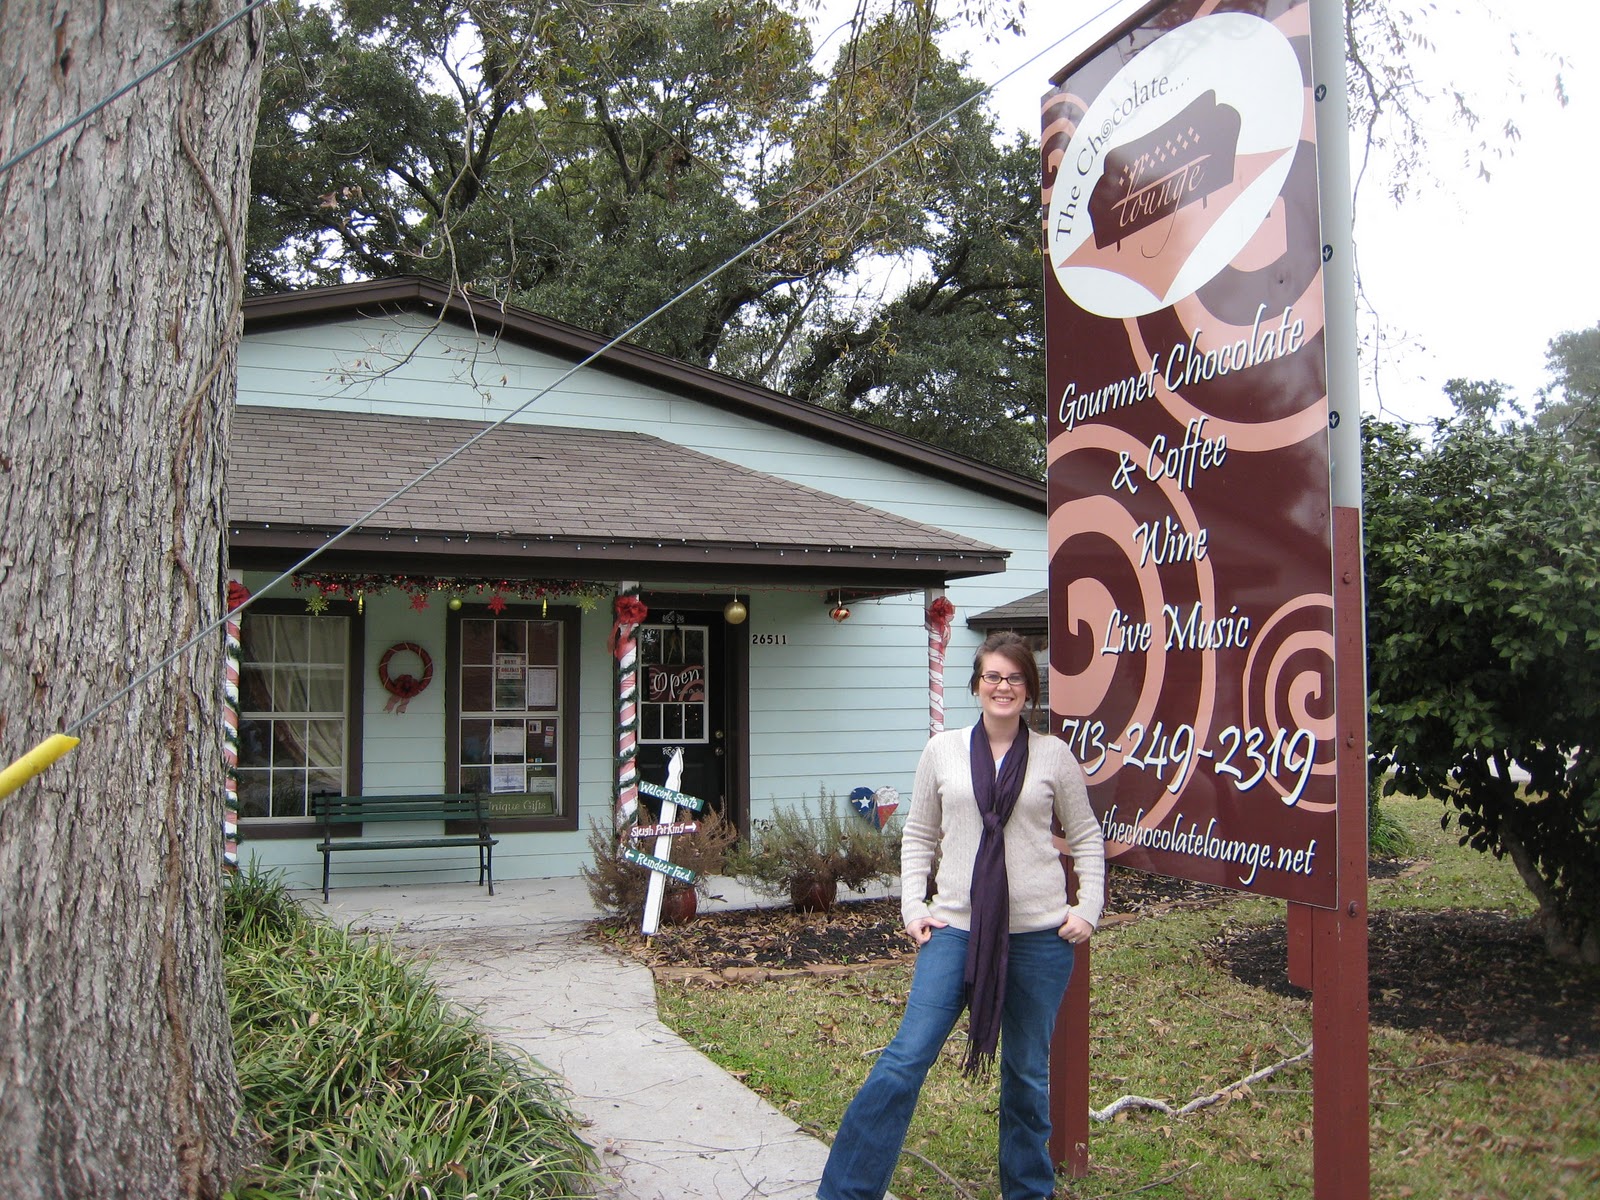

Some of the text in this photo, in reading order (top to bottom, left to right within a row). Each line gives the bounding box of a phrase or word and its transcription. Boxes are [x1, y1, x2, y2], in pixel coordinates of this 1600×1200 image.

[1056, 186, 1081, 242] The
[1059, 303, 1304, 431] Gourmet Chocolate
[1112, 415, 1226, 494] & Coffee
[1132, 516, 1208, 568] Wine
[752, 634, 787, 645] 26511
[1101, 601, 1250, 656] Live Music
[653, 668, 700, 699] Open
[1061, 718, 1316, 807] 713-249-2319
[489, 799, 546, 813] nique Gifts
[674, 792, 698, 809] Santa
[631, 825, 654, 837] Sleigh
[636, 853, 673, 873] Reindeer
